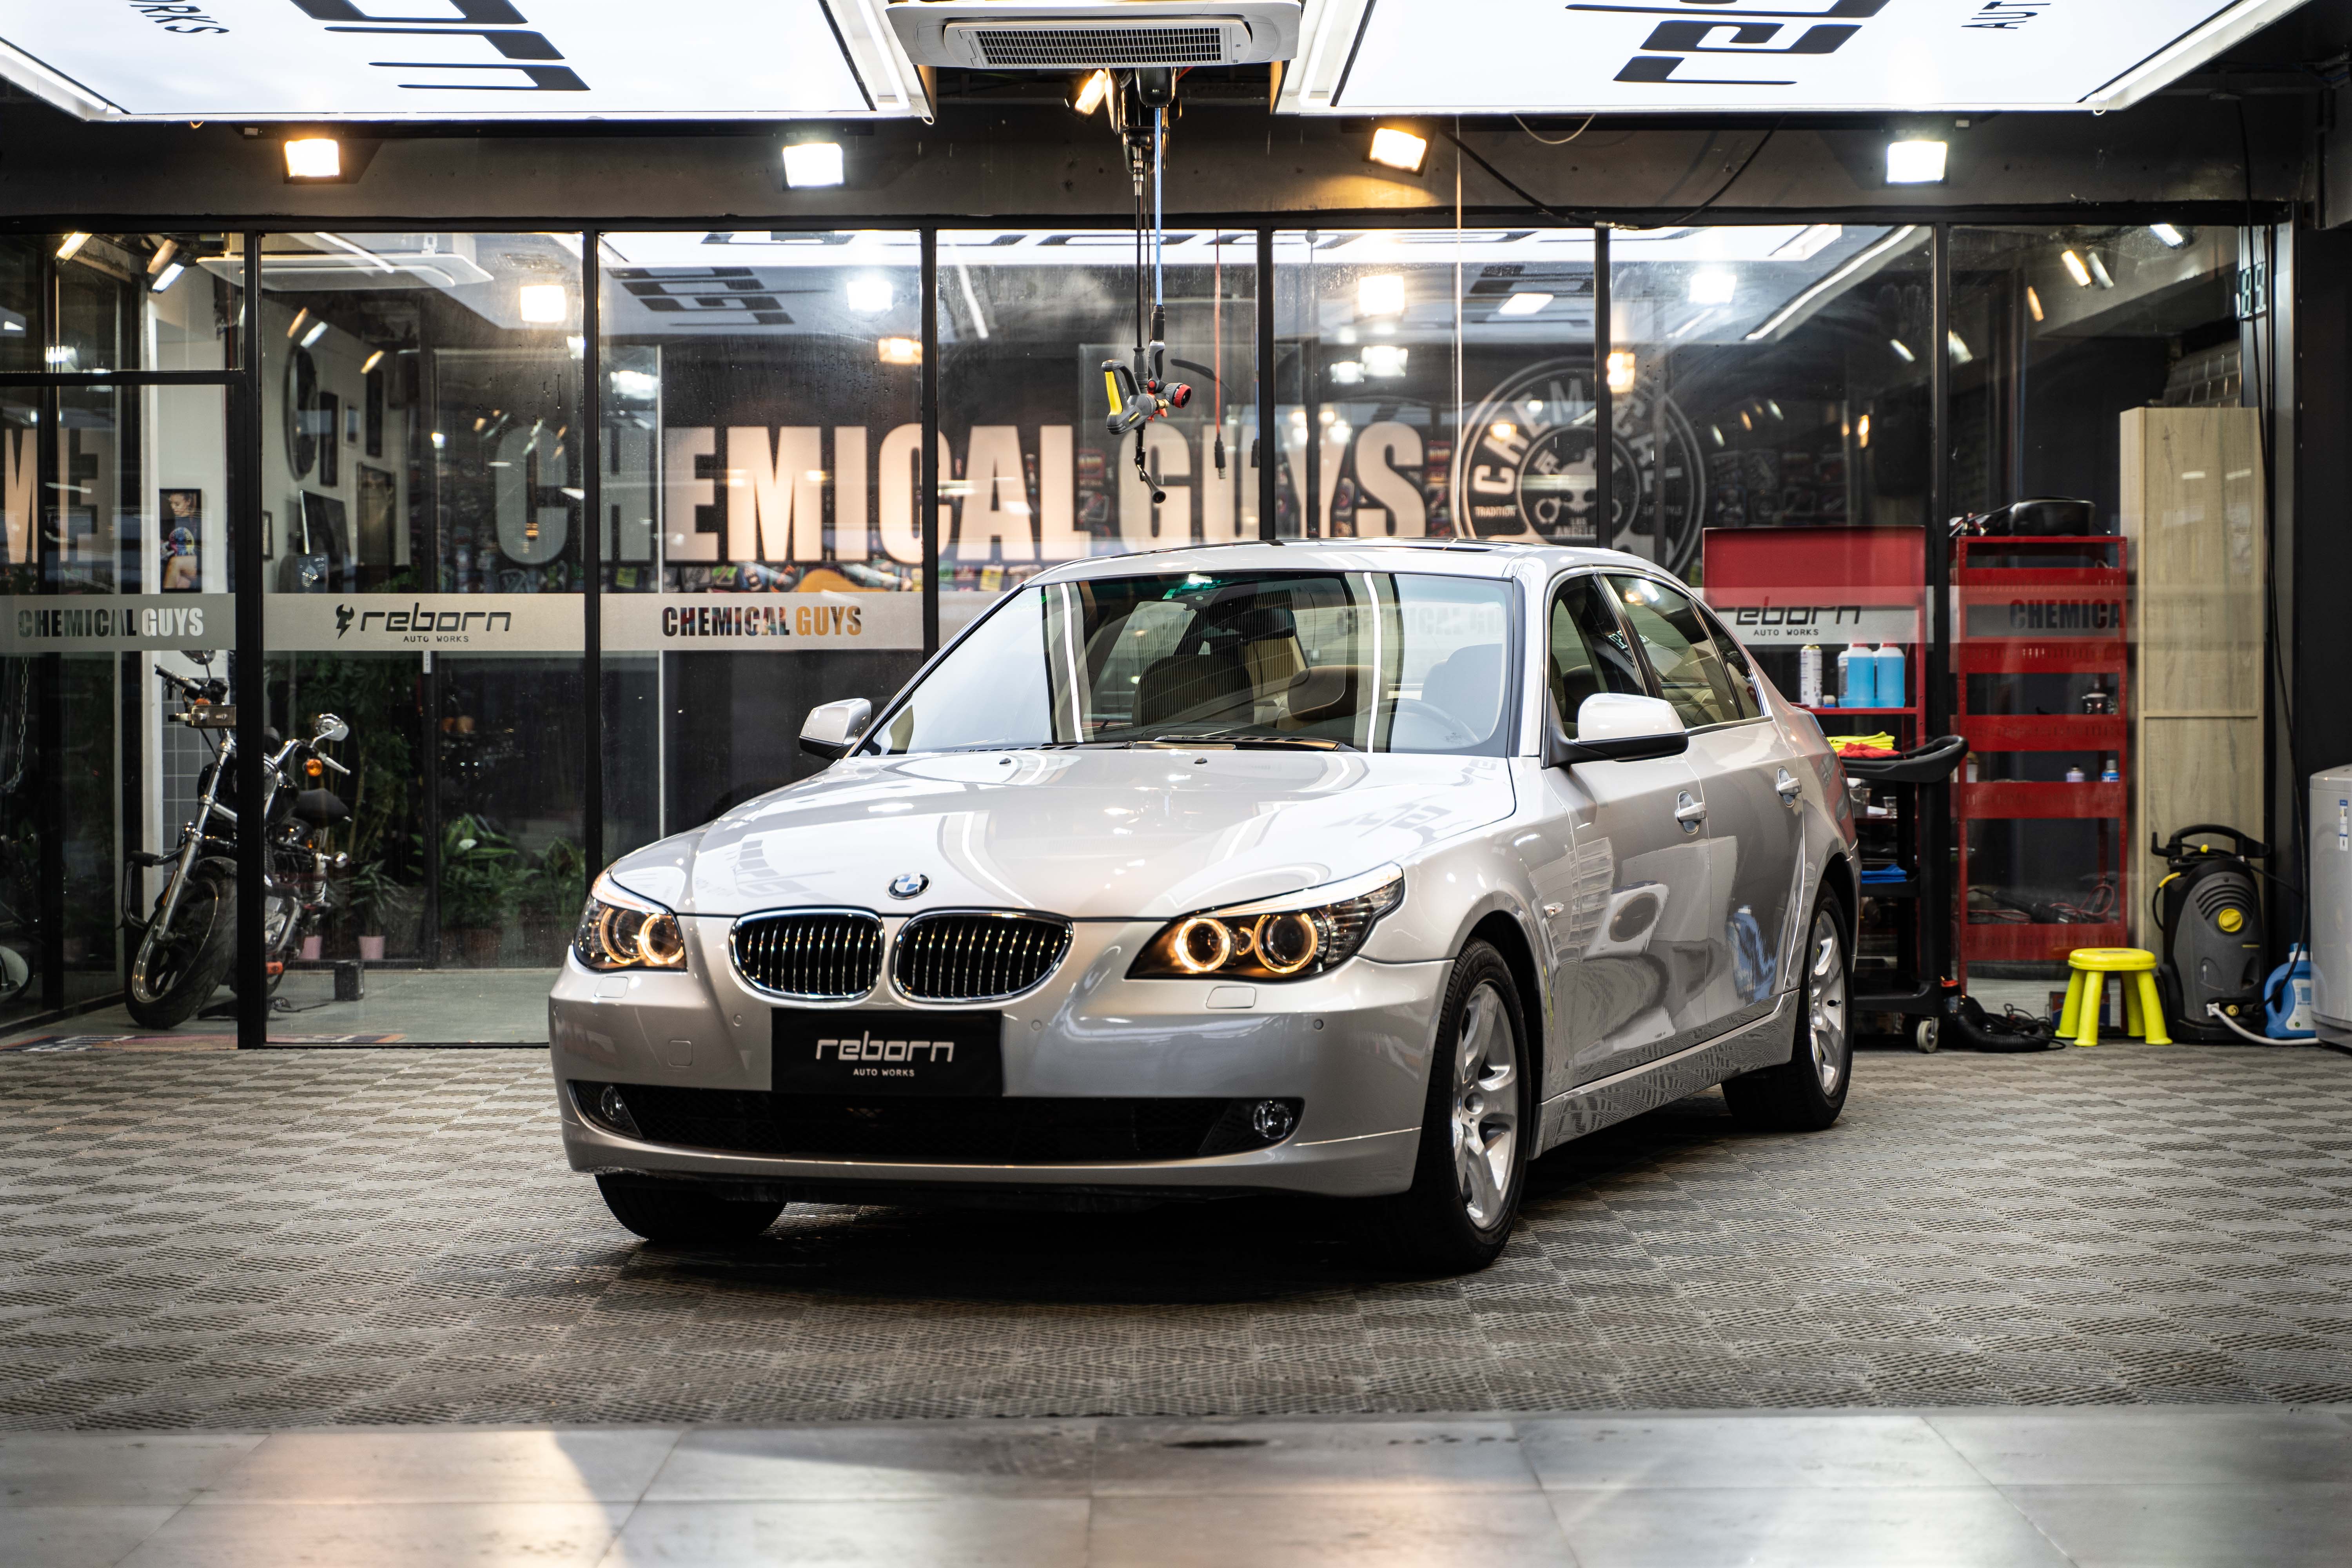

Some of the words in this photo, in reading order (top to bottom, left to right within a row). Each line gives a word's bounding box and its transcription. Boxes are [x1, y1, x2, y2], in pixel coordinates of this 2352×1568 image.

[1961, 1, 2051, 29] AUT
[495, 423, 1091, 565] CHEMICAL
[1118, 421, 1426, 550] GUYS
[18, 608, 137, 638] CHEMICAL
[142, 607, 204, 637] GUYS
[360, 603, 511, 632] reborn
[662, 606, 790, 637] CHEMICAL
[796, 606, 861, 636] GUYS
[2010, 599, 2133, 629] CHEMICA
[816, 1031, 954, 1062] reborn
[882, 1069, 915, 1077] WORKS
